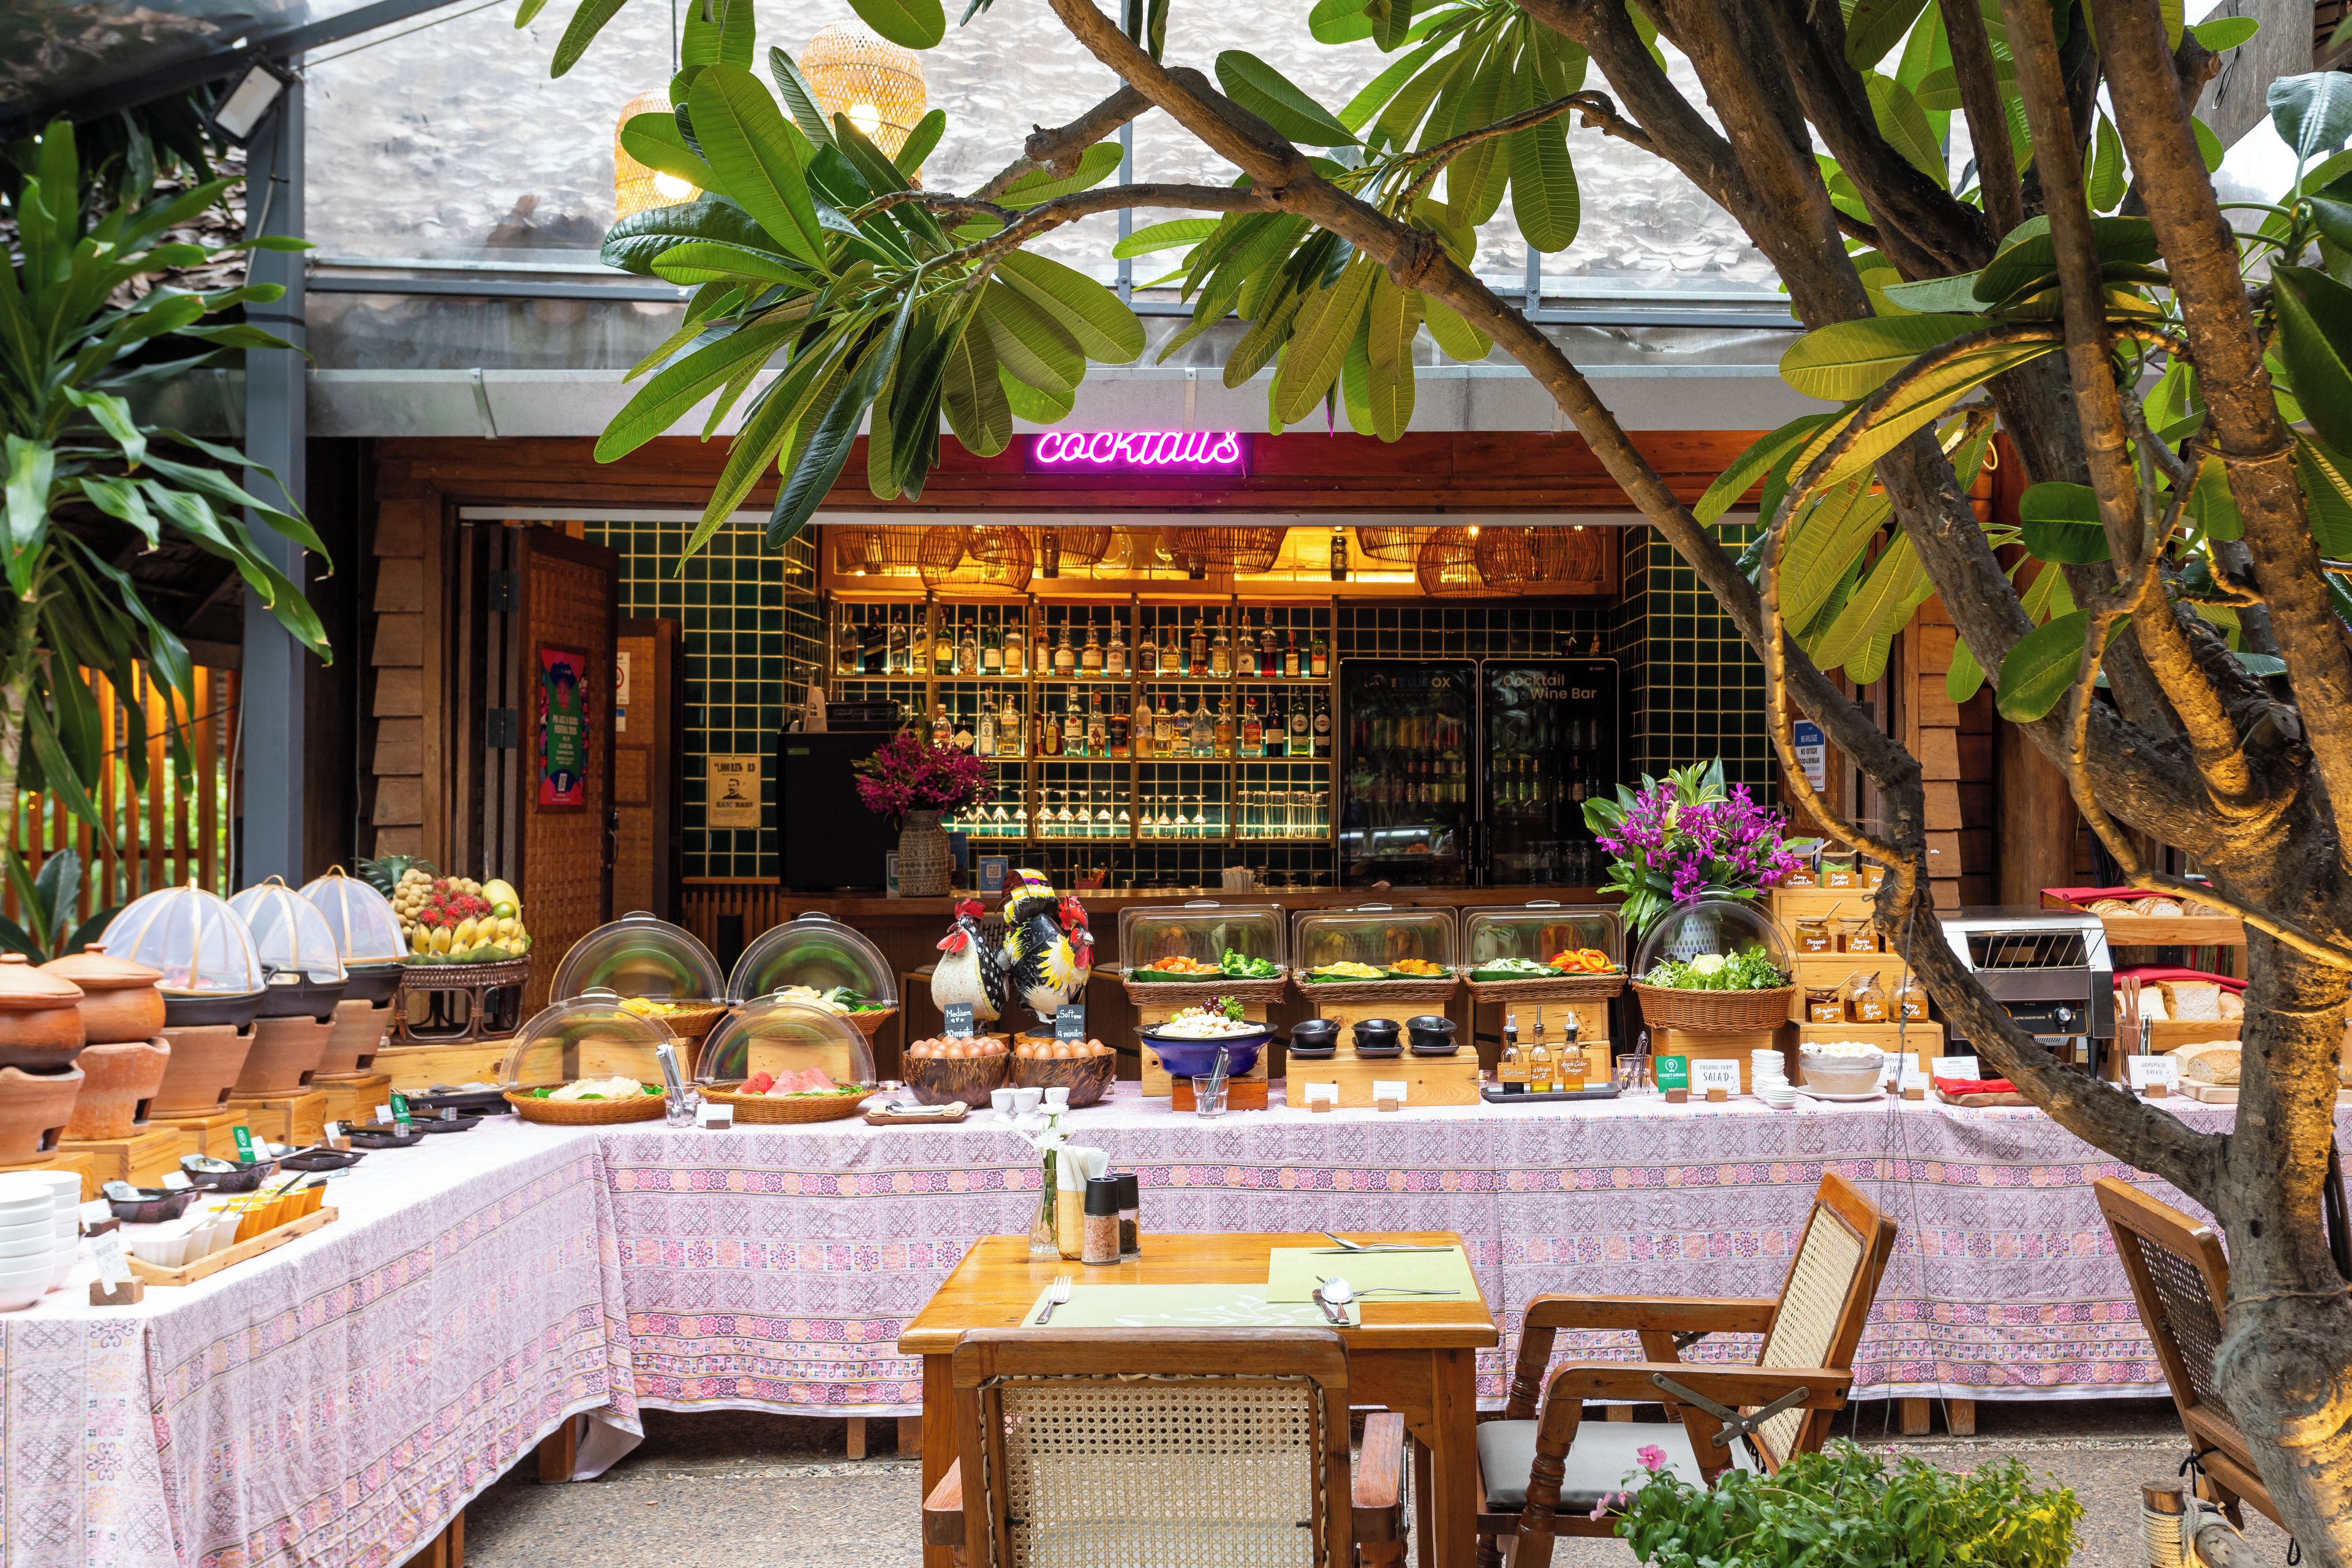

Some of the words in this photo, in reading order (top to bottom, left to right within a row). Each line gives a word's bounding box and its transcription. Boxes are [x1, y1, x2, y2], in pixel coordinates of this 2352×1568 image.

[1035, 431, 1241, 465] cocktails
[1431, 677, 1452, 688] OX
[1503, 674, 1566, 687] Cocktail
[1529, 687, 1568, 700] Wine
[1572, 688, 1597, 699] Bar
[731, 763, 756, 772] REWRD
[1814, 1006, 1841, 1016] Strawberry
[1863, 1003, 1879, 1012] Maple
[1903, 1001, 1919, 1011] Honey
[946, 1007, 972, 1017] Medium
[1060, 1009, 1074, 1018] Soft
[954, 1026, 974, 1037] minutes
[1057, 1030, 1062, 1038] 4
[1063, 1028, 1084, 1038] minutes
[1502, 1068, 1527, 1077] Balsamic
[1565, 1067, 1583, 1076] Vinegar
[1888, 1065, 1904, 1075] JAM
[1703, 1072, 1729, 1082] SALAD
